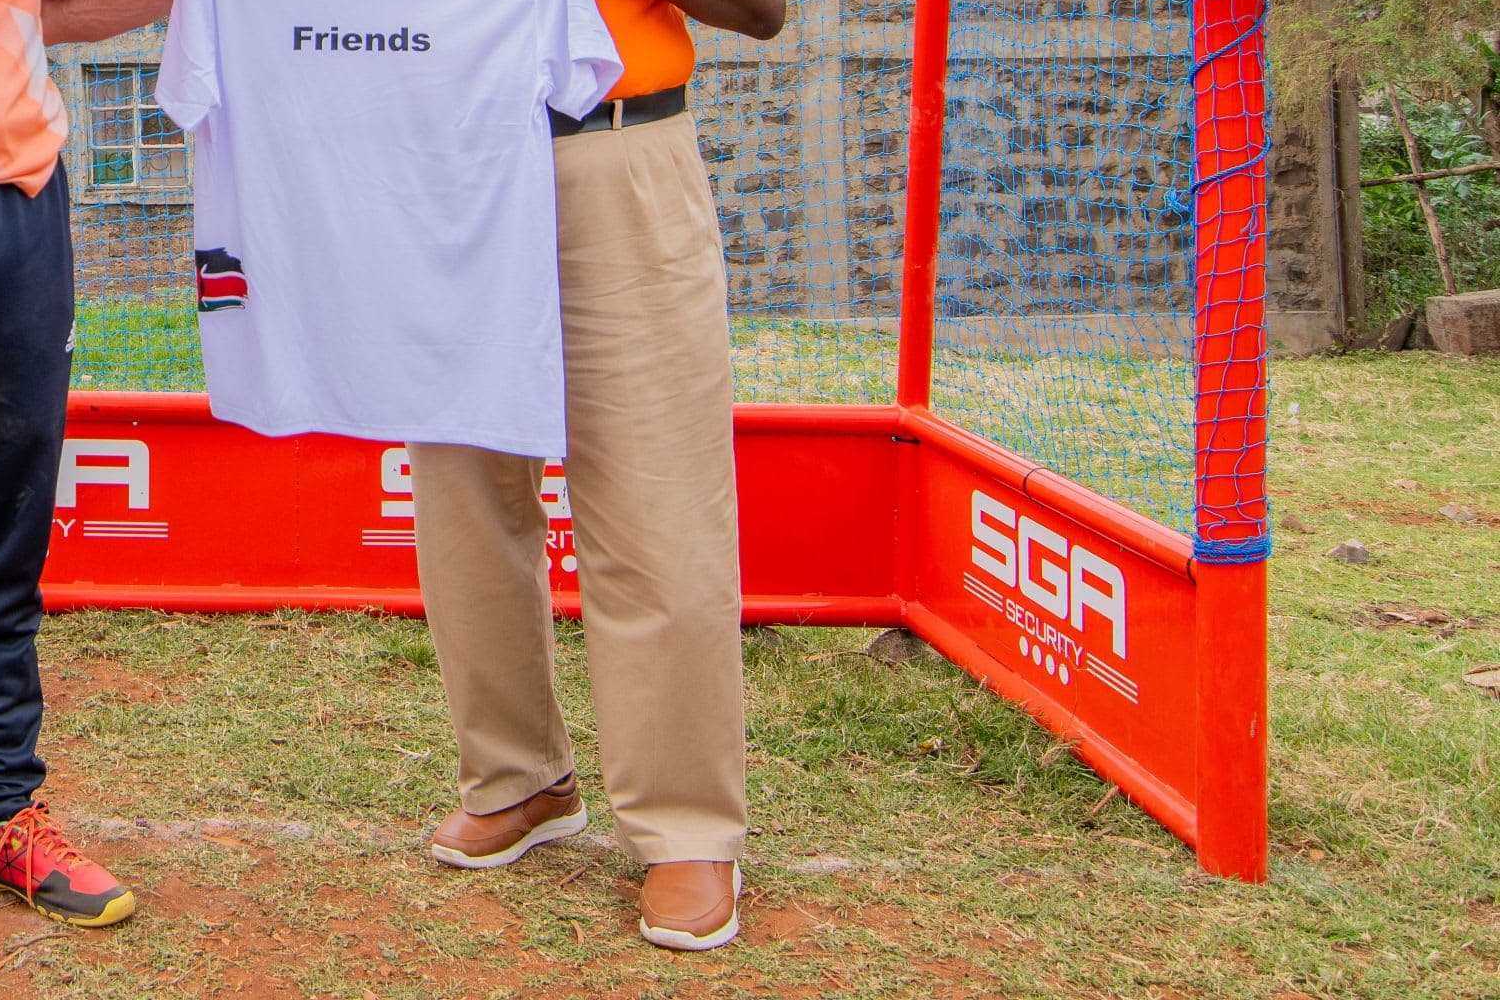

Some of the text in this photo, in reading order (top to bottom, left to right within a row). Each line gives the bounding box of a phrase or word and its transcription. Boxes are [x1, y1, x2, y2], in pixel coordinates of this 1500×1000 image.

[293, 26, 431, 52] Friends
[971, 489, 1126, 660] SGA
[1005, 599, 1083, 666] SECURITY
